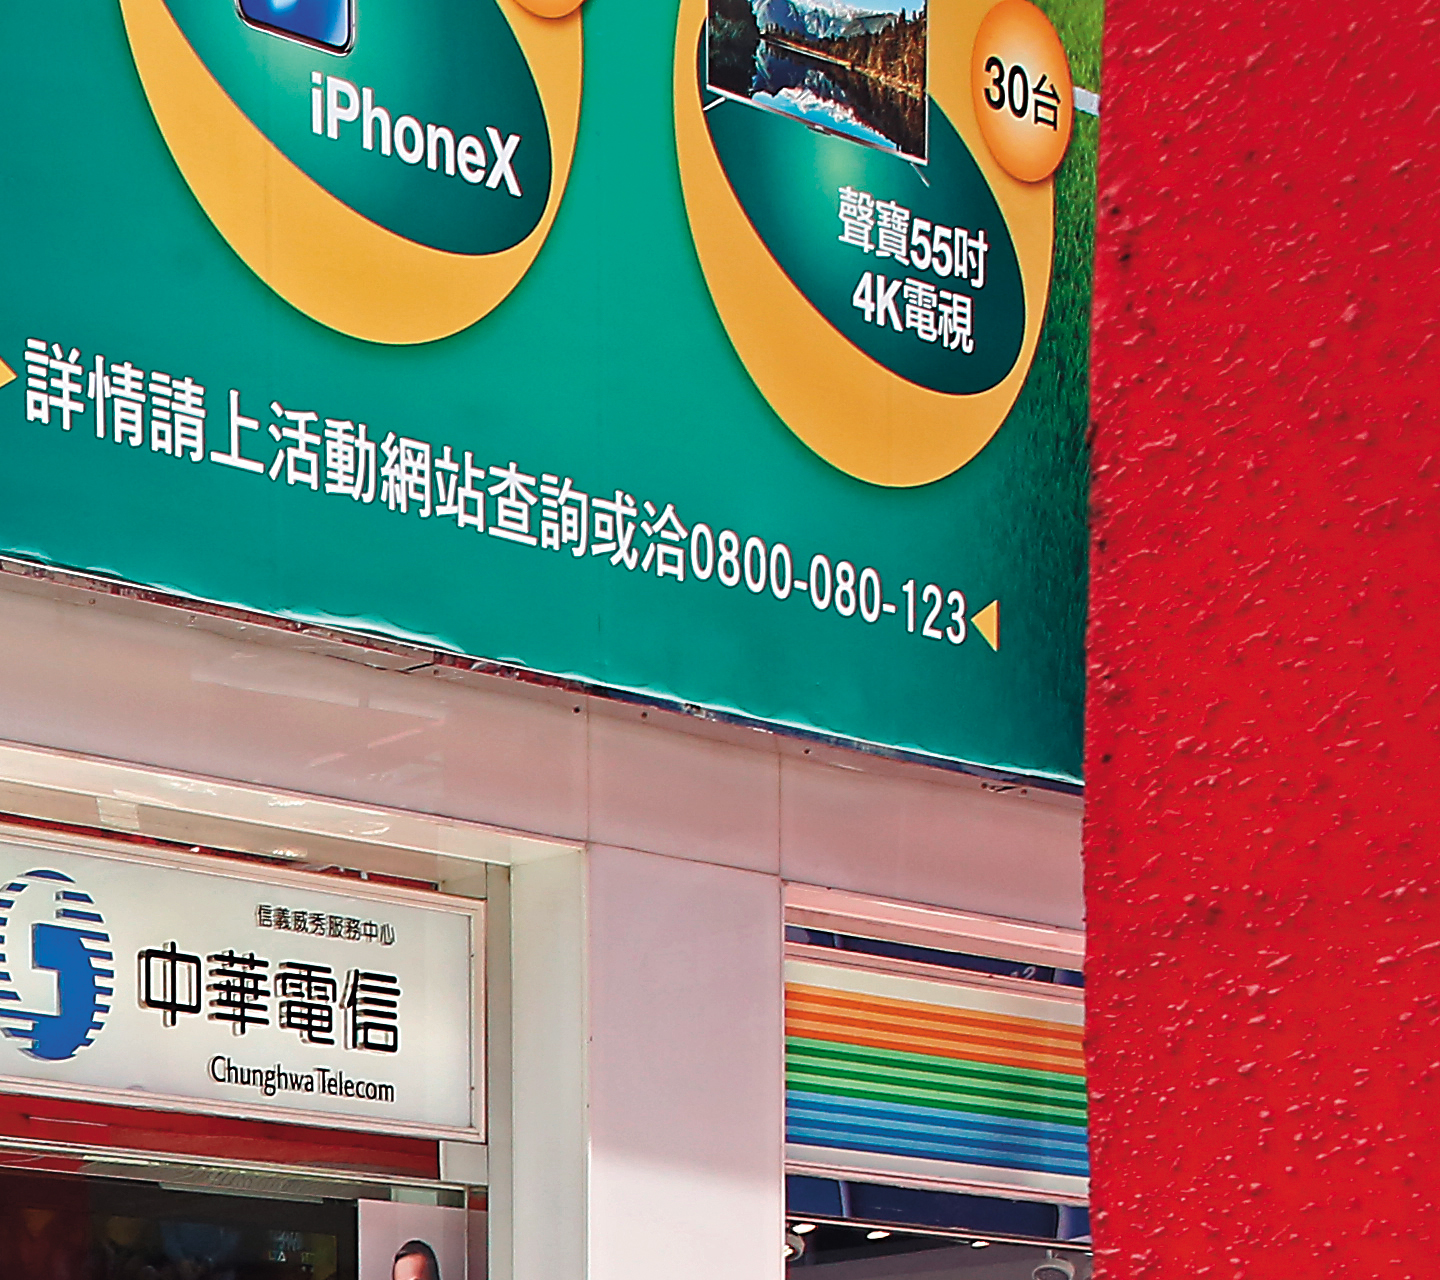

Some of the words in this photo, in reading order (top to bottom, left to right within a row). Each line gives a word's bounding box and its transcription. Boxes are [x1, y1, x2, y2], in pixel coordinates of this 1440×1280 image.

[310, 73, 522, 197] iPhoneX
[983, 54, 1061, 132] 30台
[837, 184, 988, 290] 聲寶55吋
[852, 271, 975, 355] 4K電視
[24, 337, 967, 647] 詳情請上活動網站查詢或洽0800-080-123
[254, 902, 397, 947] 信義威秀服務中心
[137, 941, 402, 1054] 中華電信
[208, 1055, 314, 1097] Chunghwa
[314, 1066, 396, 1103] Telecom
